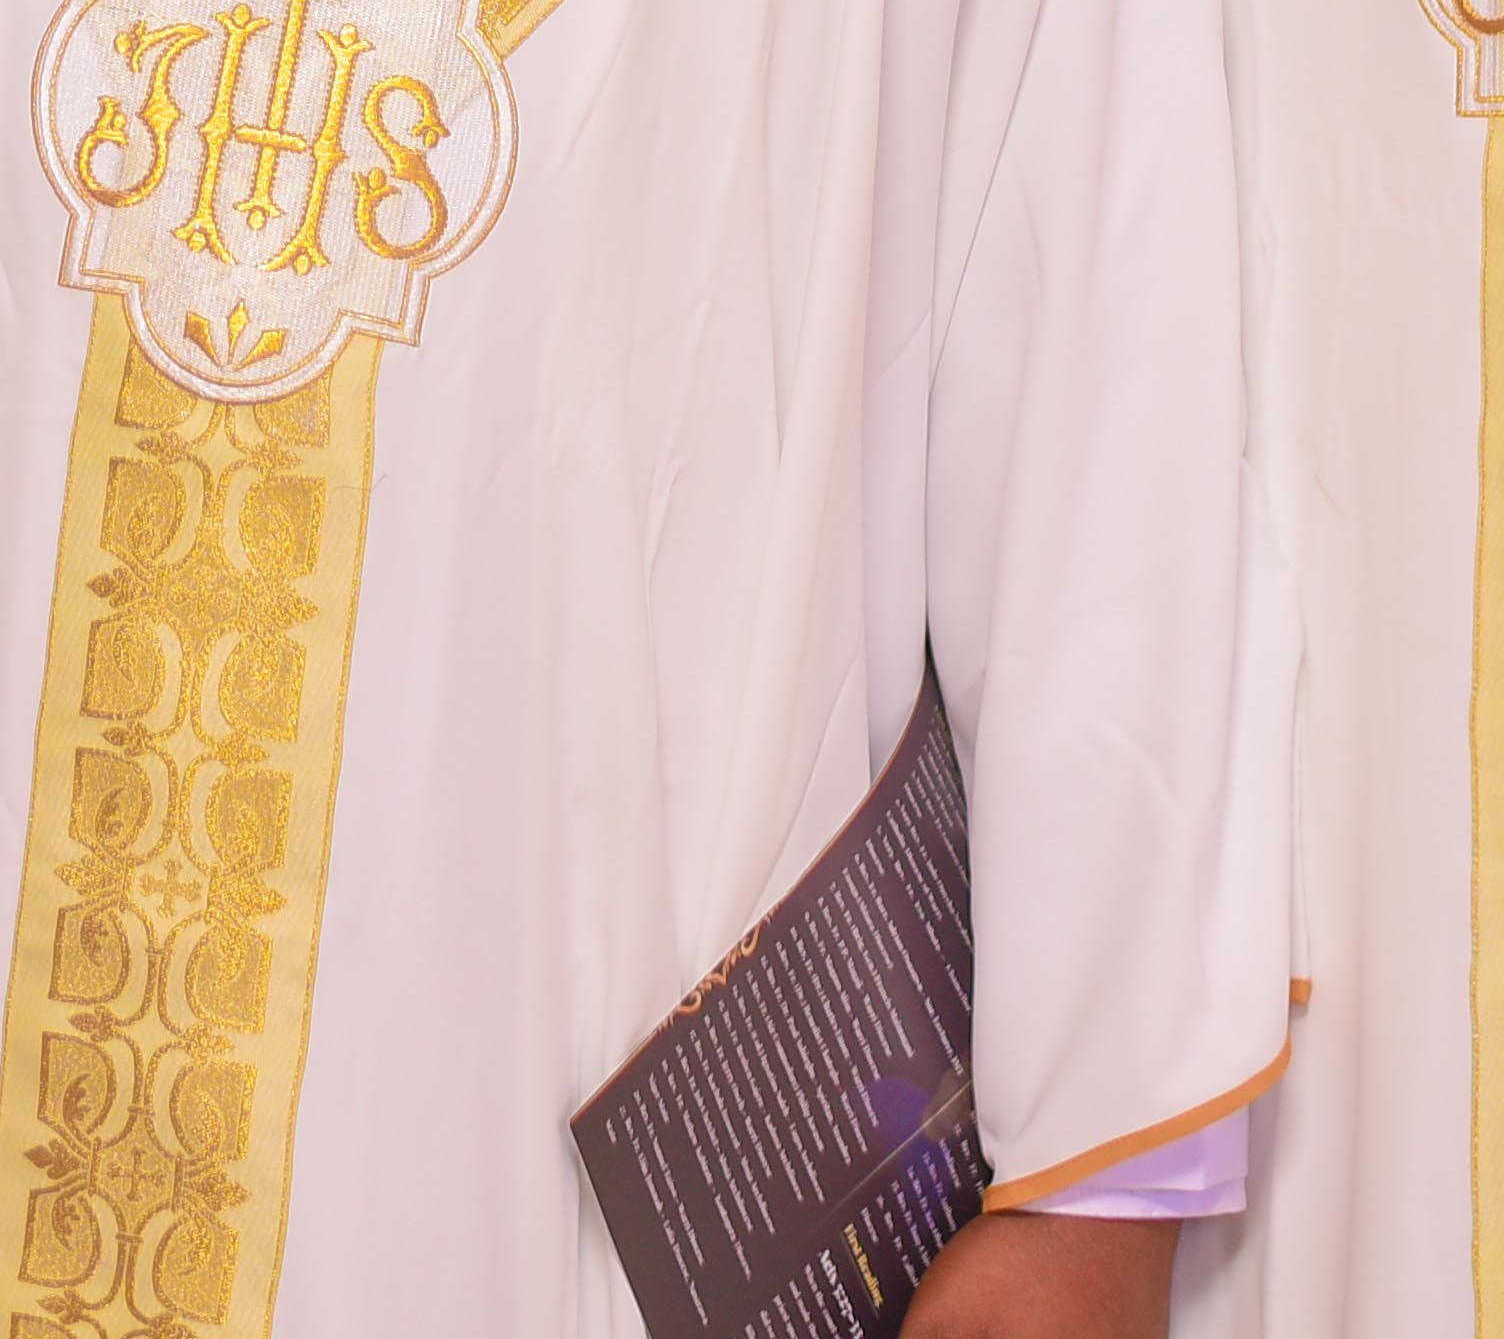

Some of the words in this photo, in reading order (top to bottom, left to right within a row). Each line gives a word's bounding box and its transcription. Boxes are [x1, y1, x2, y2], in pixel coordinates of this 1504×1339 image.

[818, 1249, 837, 1286] Acts
[843, 1223, 863, 1257] First
[857, 1253, 883, 1308] Reading
